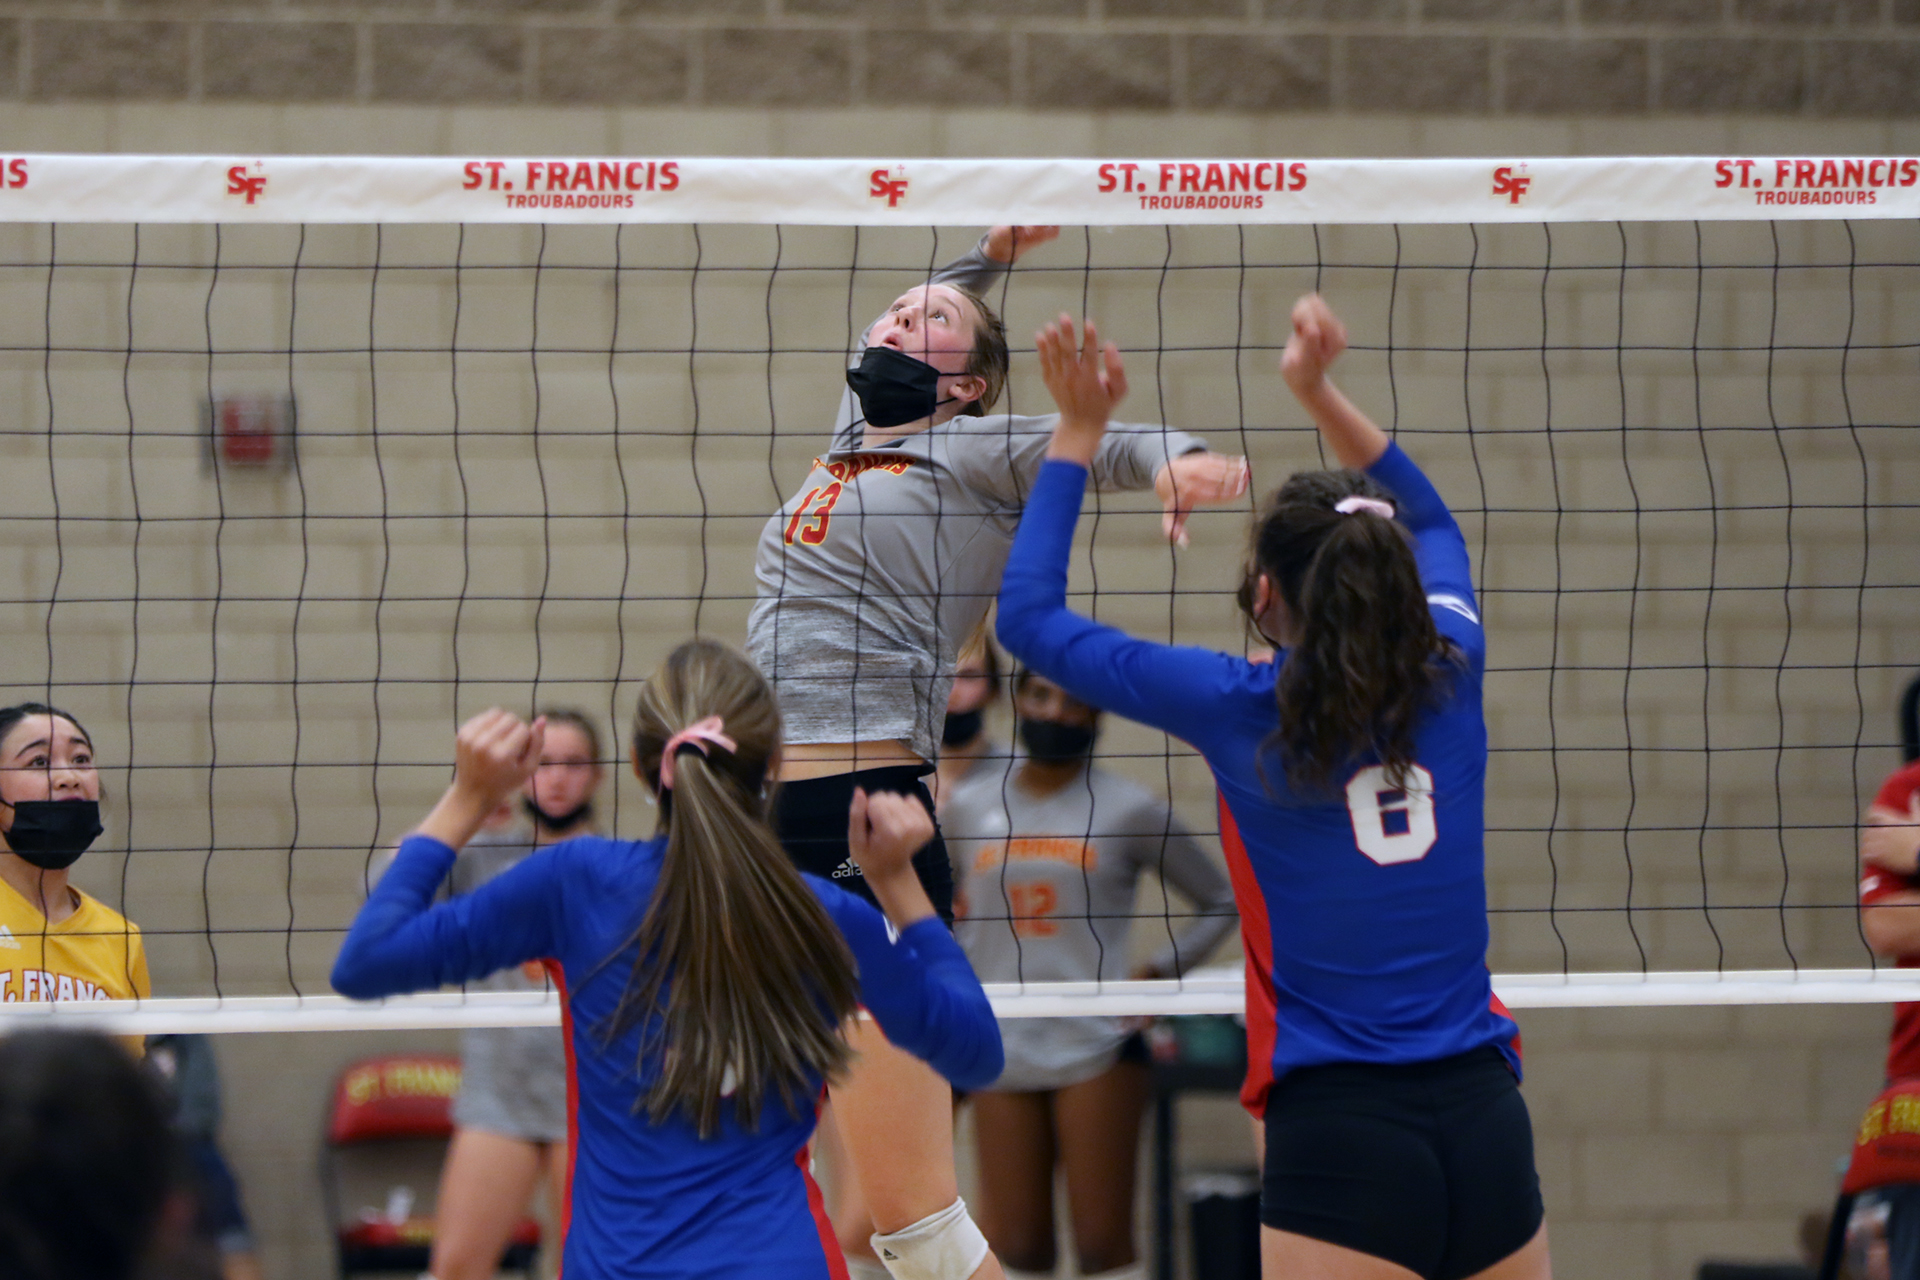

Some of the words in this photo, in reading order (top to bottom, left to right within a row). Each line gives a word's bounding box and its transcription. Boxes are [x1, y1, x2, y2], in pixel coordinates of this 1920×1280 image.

[462, 161, 514, 191] ST.
[525, 161, 680, 191] FRANCIS
[1097, 163, 1147, 193] ST.
[1158, 162, 1308, 192] FRANCIS
[1714, 159, 1763, 188] ST.
[1774, 159, 1920, 188] FRANCIS
[505, 194, 635, 209] TROUBADOURS
[1138, 195, 1264, 210] TROUBADOURS
[1754, 190, 1878, 205] TROUBADOURS
[784, 481, 842, 546] 13
